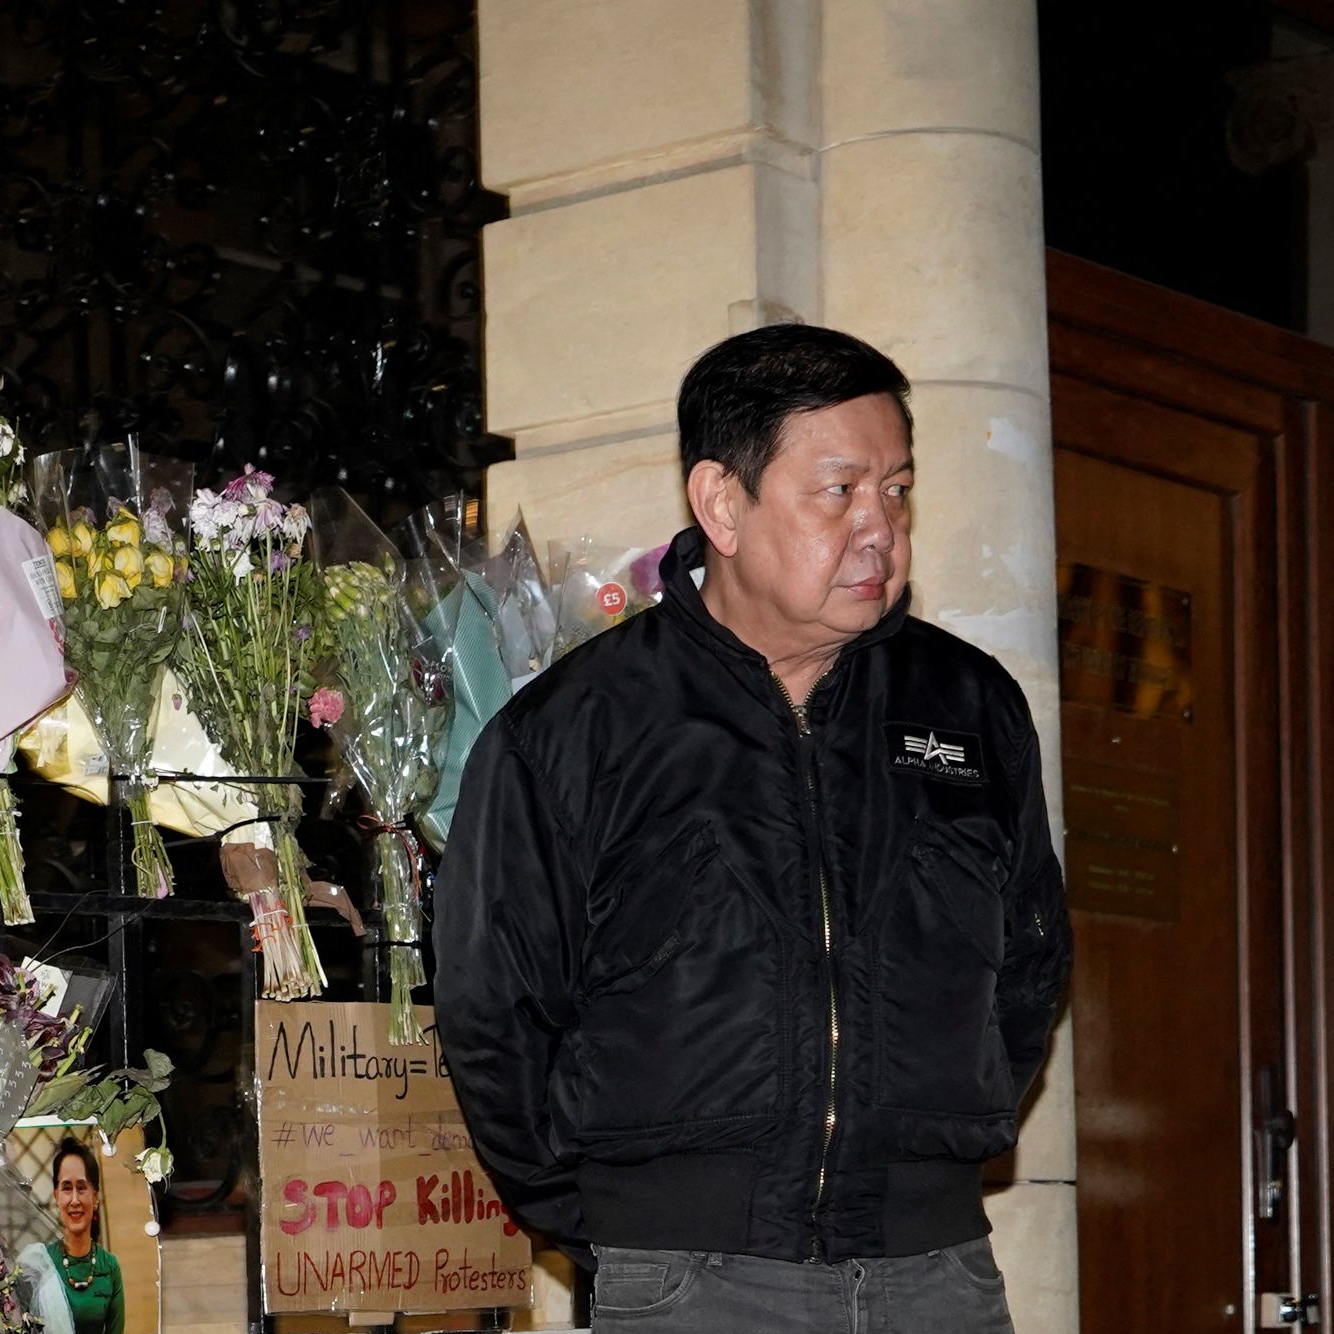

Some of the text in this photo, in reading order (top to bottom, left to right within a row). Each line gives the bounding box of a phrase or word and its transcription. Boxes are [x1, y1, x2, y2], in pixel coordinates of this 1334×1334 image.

[603, 592, 620, 607] £5
[895, 756, 980, 778] ALPHA INDUSTRIES
[279, 1169, 521, 1238] STOP Killing
[276, 1247, 528, 1298] UNARMED Protesters
